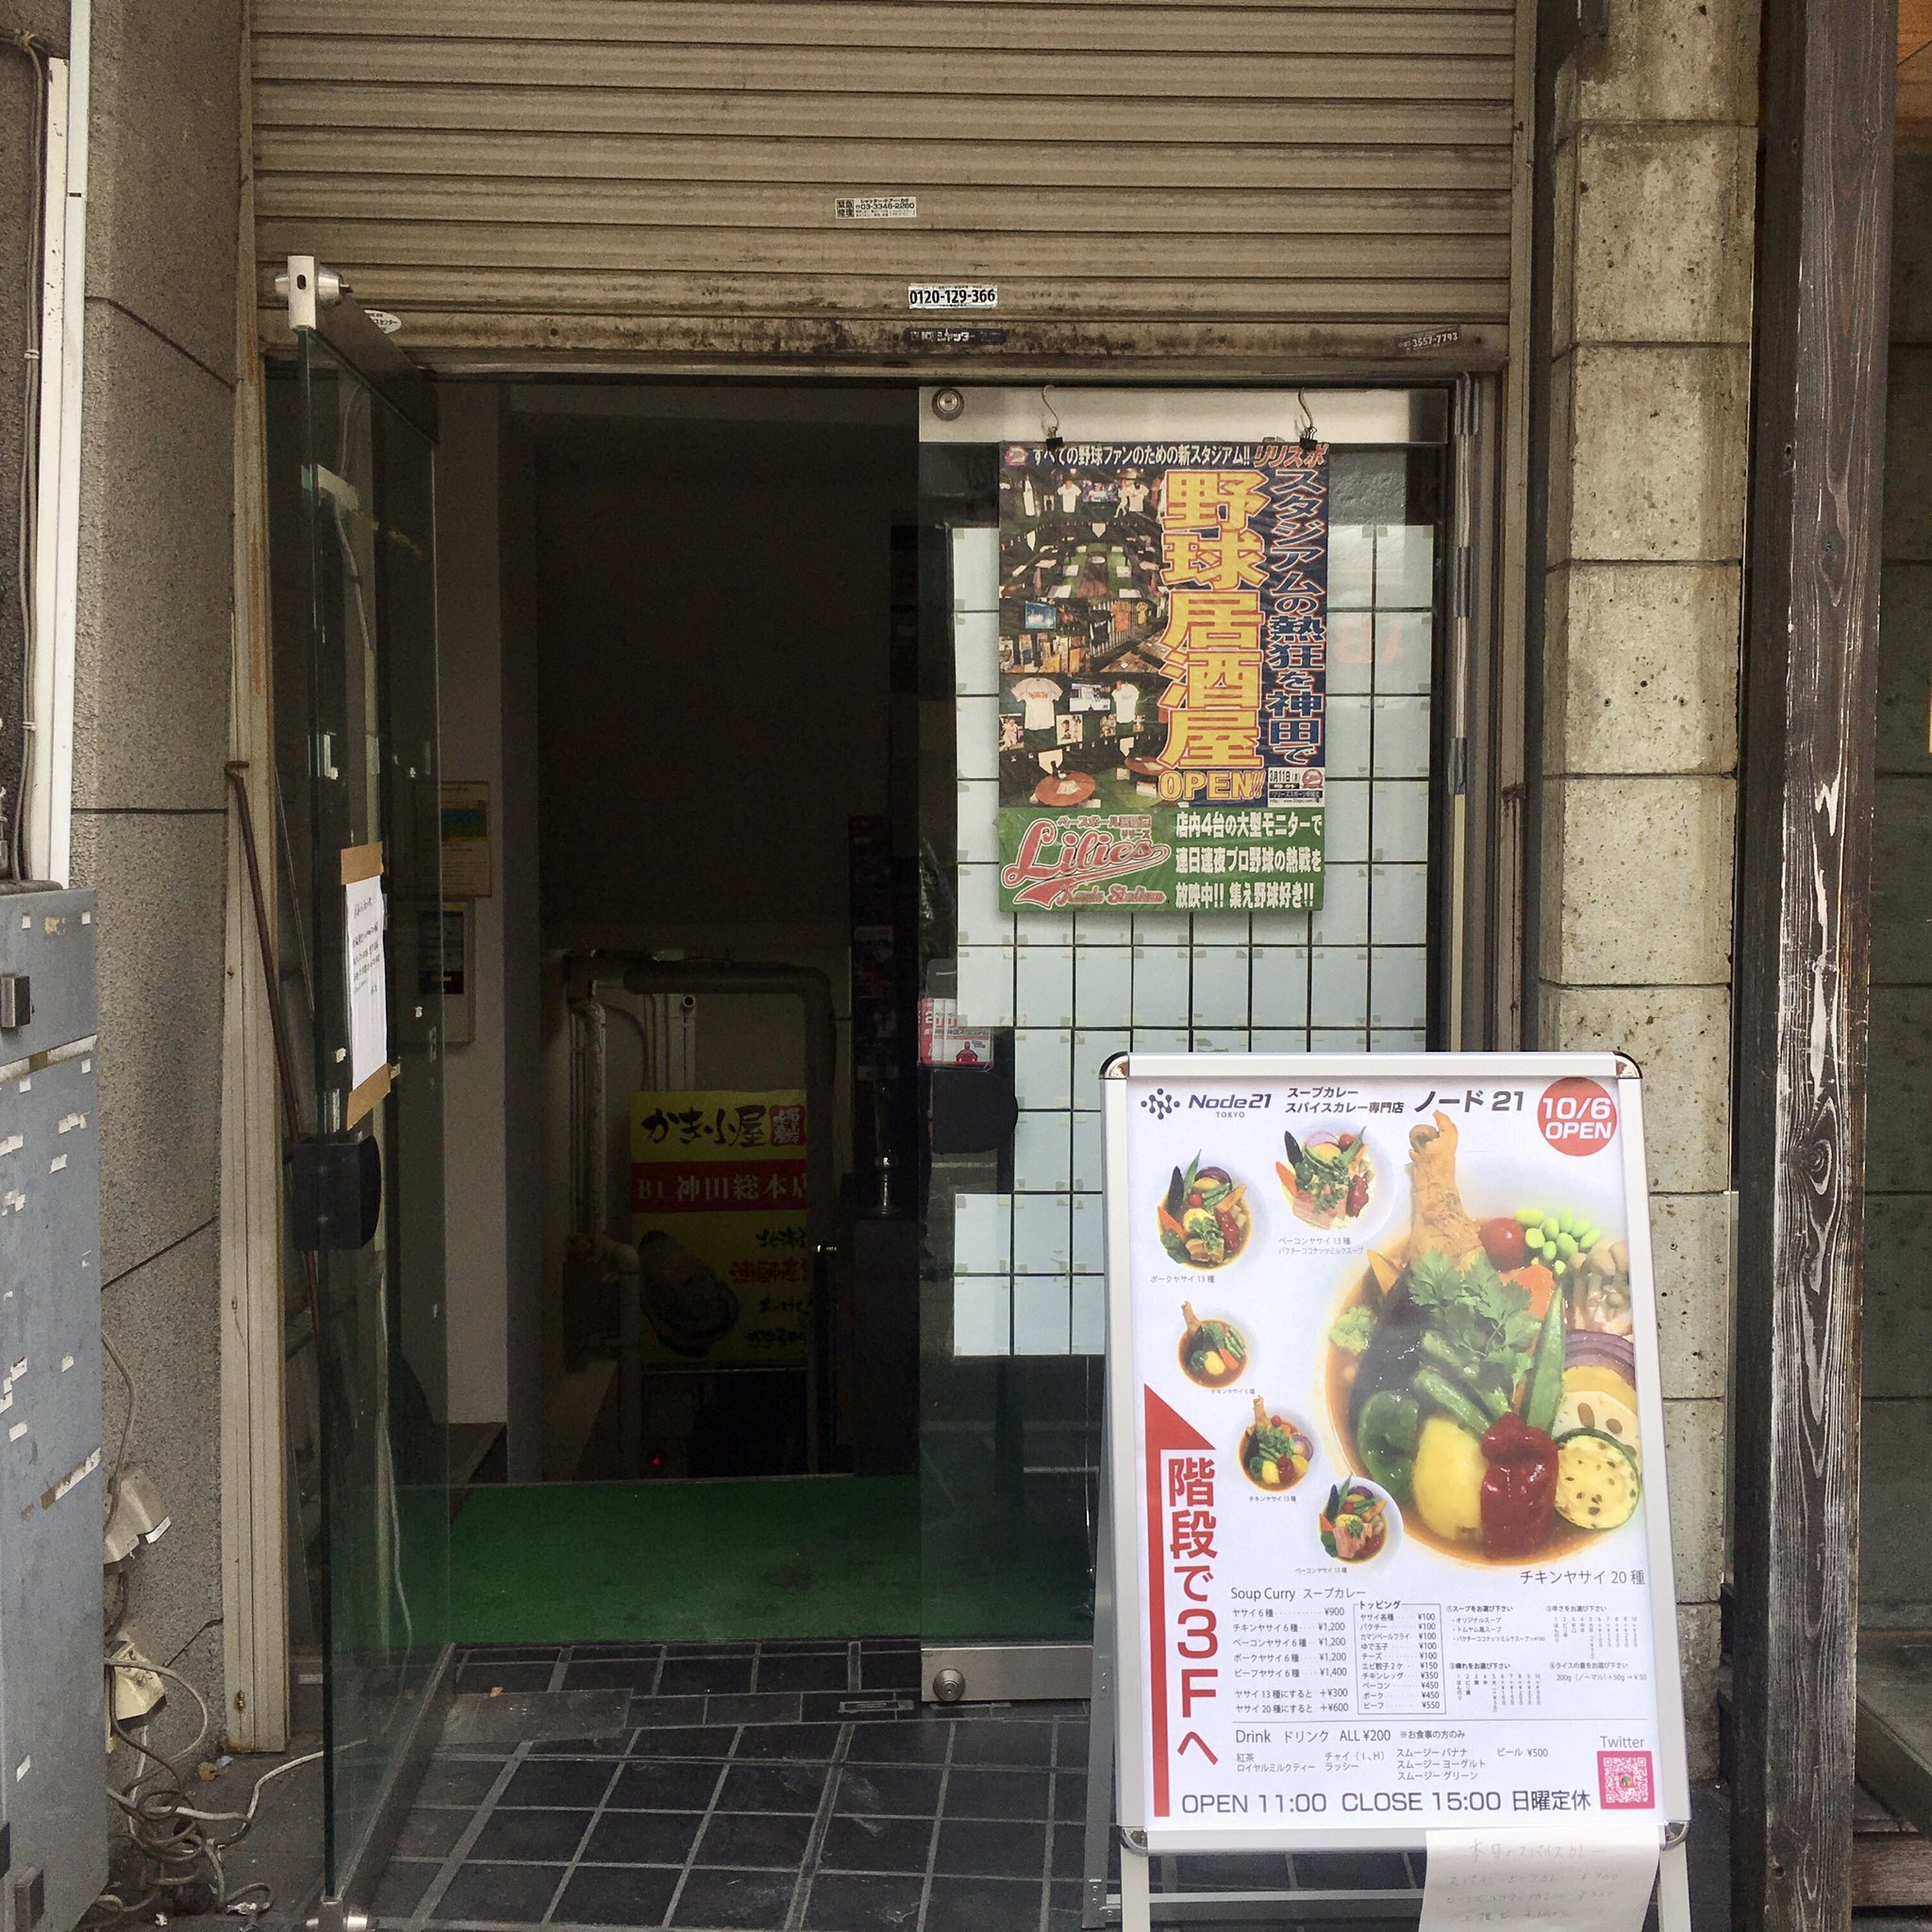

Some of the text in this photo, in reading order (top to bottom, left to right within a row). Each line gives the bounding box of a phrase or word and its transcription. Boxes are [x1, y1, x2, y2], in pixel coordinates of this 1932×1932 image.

[909, 289, 996, 305] 0120-129-366
[1157, 469, 1272, 770] 野球居酒屋
[1287, 1087, 1359, 1098] スープカレー
[1189, 1093, 1273, 1109] Node21
[1414, 1091, 1524, 1113] ノード 21
[1285, 1102, 1405, 1114] スパイスカレー専門店
[1542, 1097, 1611, 1120] 10/6
[641, 1104, 766, 1148] かき小屋
[1545, 1121, 1612, 1140] OPEN
[1230, 1587, 1366, 1603] Soup Curry スープカレー
[1359, 1600, 1401, 1609] トッピング
[1169, 1456, 1220, 1767] 階段で3Fへ
[1324, 1607, 1345, 1616] ¥900
[1318, 1622, 1346, 1632] ¥1,200
[1419, 1632, 1438, 1641] ¥100
[1318, 1637, 1346, 1647] ¥1,200
[1419, 1641, 1438, 1650] ¥100
[1319, 1652, 1347, 1662] ¥1,200
[1420, 1661, 1439, 1670] ¥150
[1319, 1667, 1348, 1677] ¥1,400
[1362, 1672, 1405, 1680] チキンレッグ
[1421, 1681, 1440, 1690] ¥450
[1320, 1688, 1349, 1697] +¥300
[1363, 1691, 1384, 1700] ポーク
[1320, 1703, 1349, 1712] +¥600
[1364, 1701, 1441, 1710] ビーフ ¥550
[1235, 1729, 1272, 1743] Drink
[1284, 1730, 1329, 1743] ドリンク
[1340, 1729, 1360, 1741] ALL
[1362, 1729, 1391, 1741] ¥200
[1600, 1736, 1645, 1749] Twitter
[1237, 1753, 1255, 1762] 紅茶
[1396, 1748, 1440, 1757] スムージー
[1441, 1748, 1468, 1757] バナナ
[1497, 1747, 1524, 1757] ビール
[1526, 1748, 1549, 1757] ¥500
[1237, 1759, 1486, 1773] ロイヤルミルクティー ラッシー スムージー ヨーグルト
[1397, 1772, 1478, 1781] スムージー グリーン
[1182, 1790, 1591, 1813] OPEN 11:00 CLOSE 15:00 日曜定休
